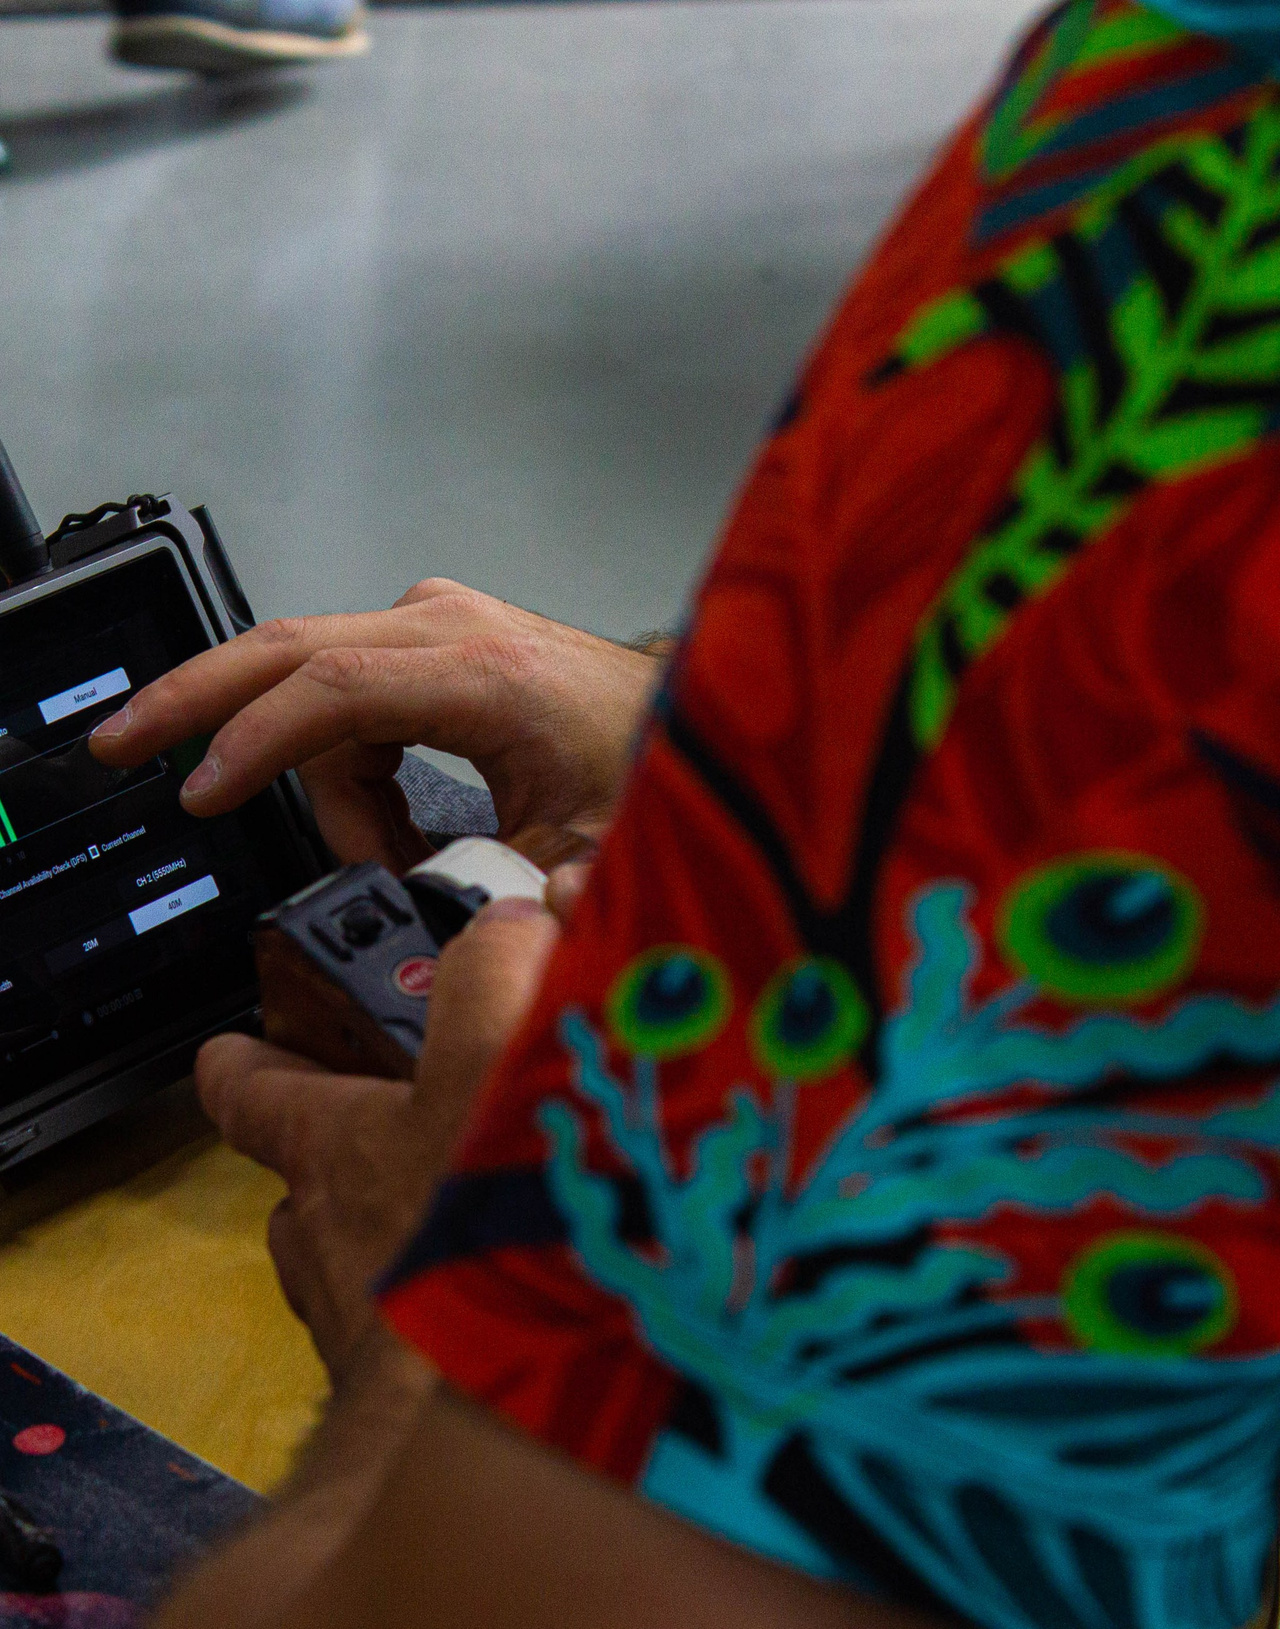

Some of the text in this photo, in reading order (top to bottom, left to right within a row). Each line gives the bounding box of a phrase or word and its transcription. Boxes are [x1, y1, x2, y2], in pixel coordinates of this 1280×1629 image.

[74, 687, 97, 703] Manual
[101, 825, 146, 852] Current Channel
[16, 850, 26, 861] 10
[22, 868, 54, 889] Availability
[52, 859, 72, 876] Check
[70, 852, 88, 869] (DFS)
[136, 857, 187, 887] CH 2 (5550MHz)
[168, 898, 183, 910] 40M
[82, 937, 99, 952] 20M
